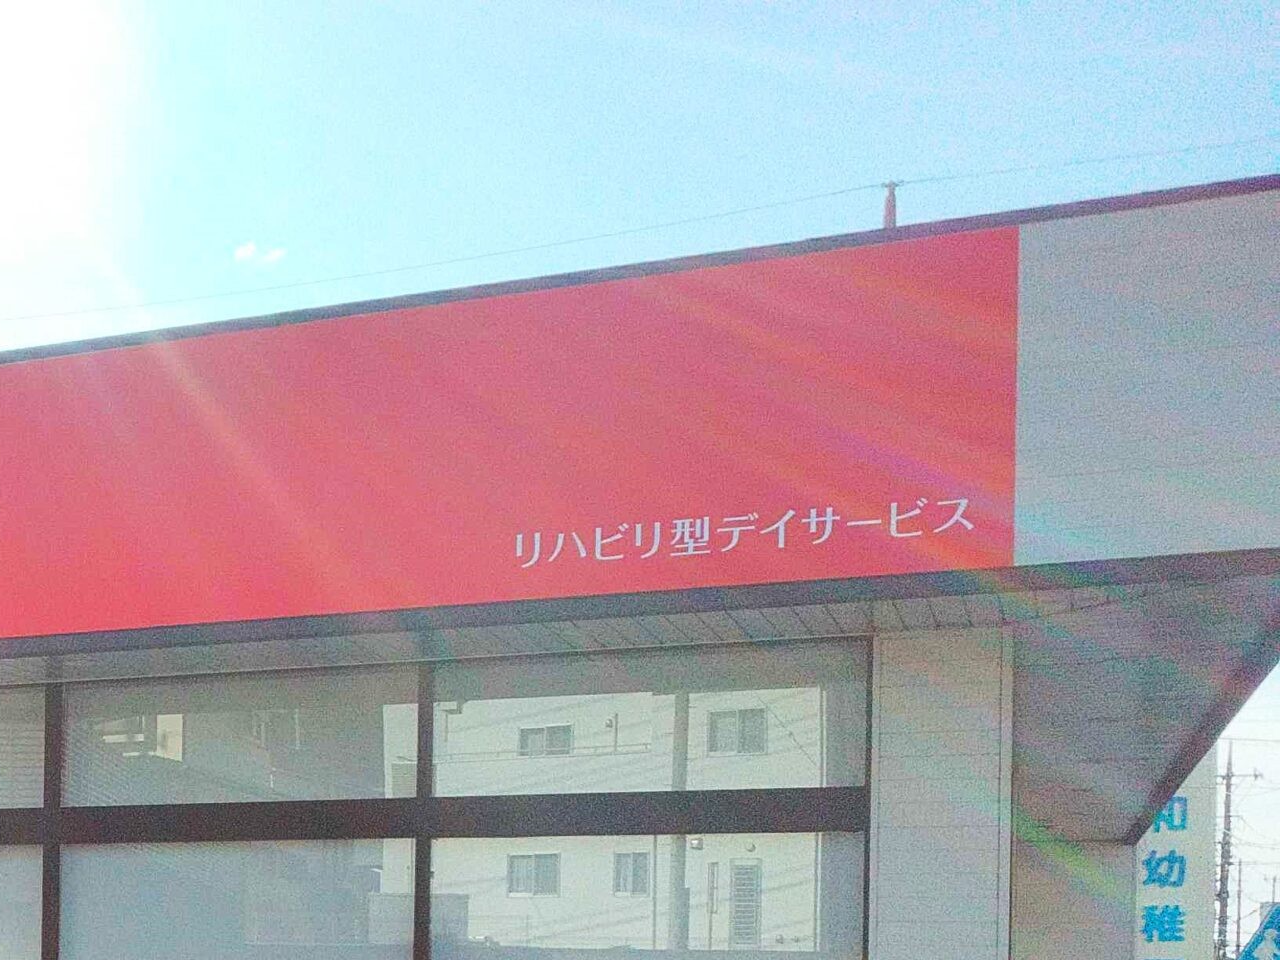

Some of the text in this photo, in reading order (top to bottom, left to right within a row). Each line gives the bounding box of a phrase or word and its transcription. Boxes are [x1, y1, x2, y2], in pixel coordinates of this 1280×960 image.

[515, 498, 975, 568] リハビリ型デイサービス
